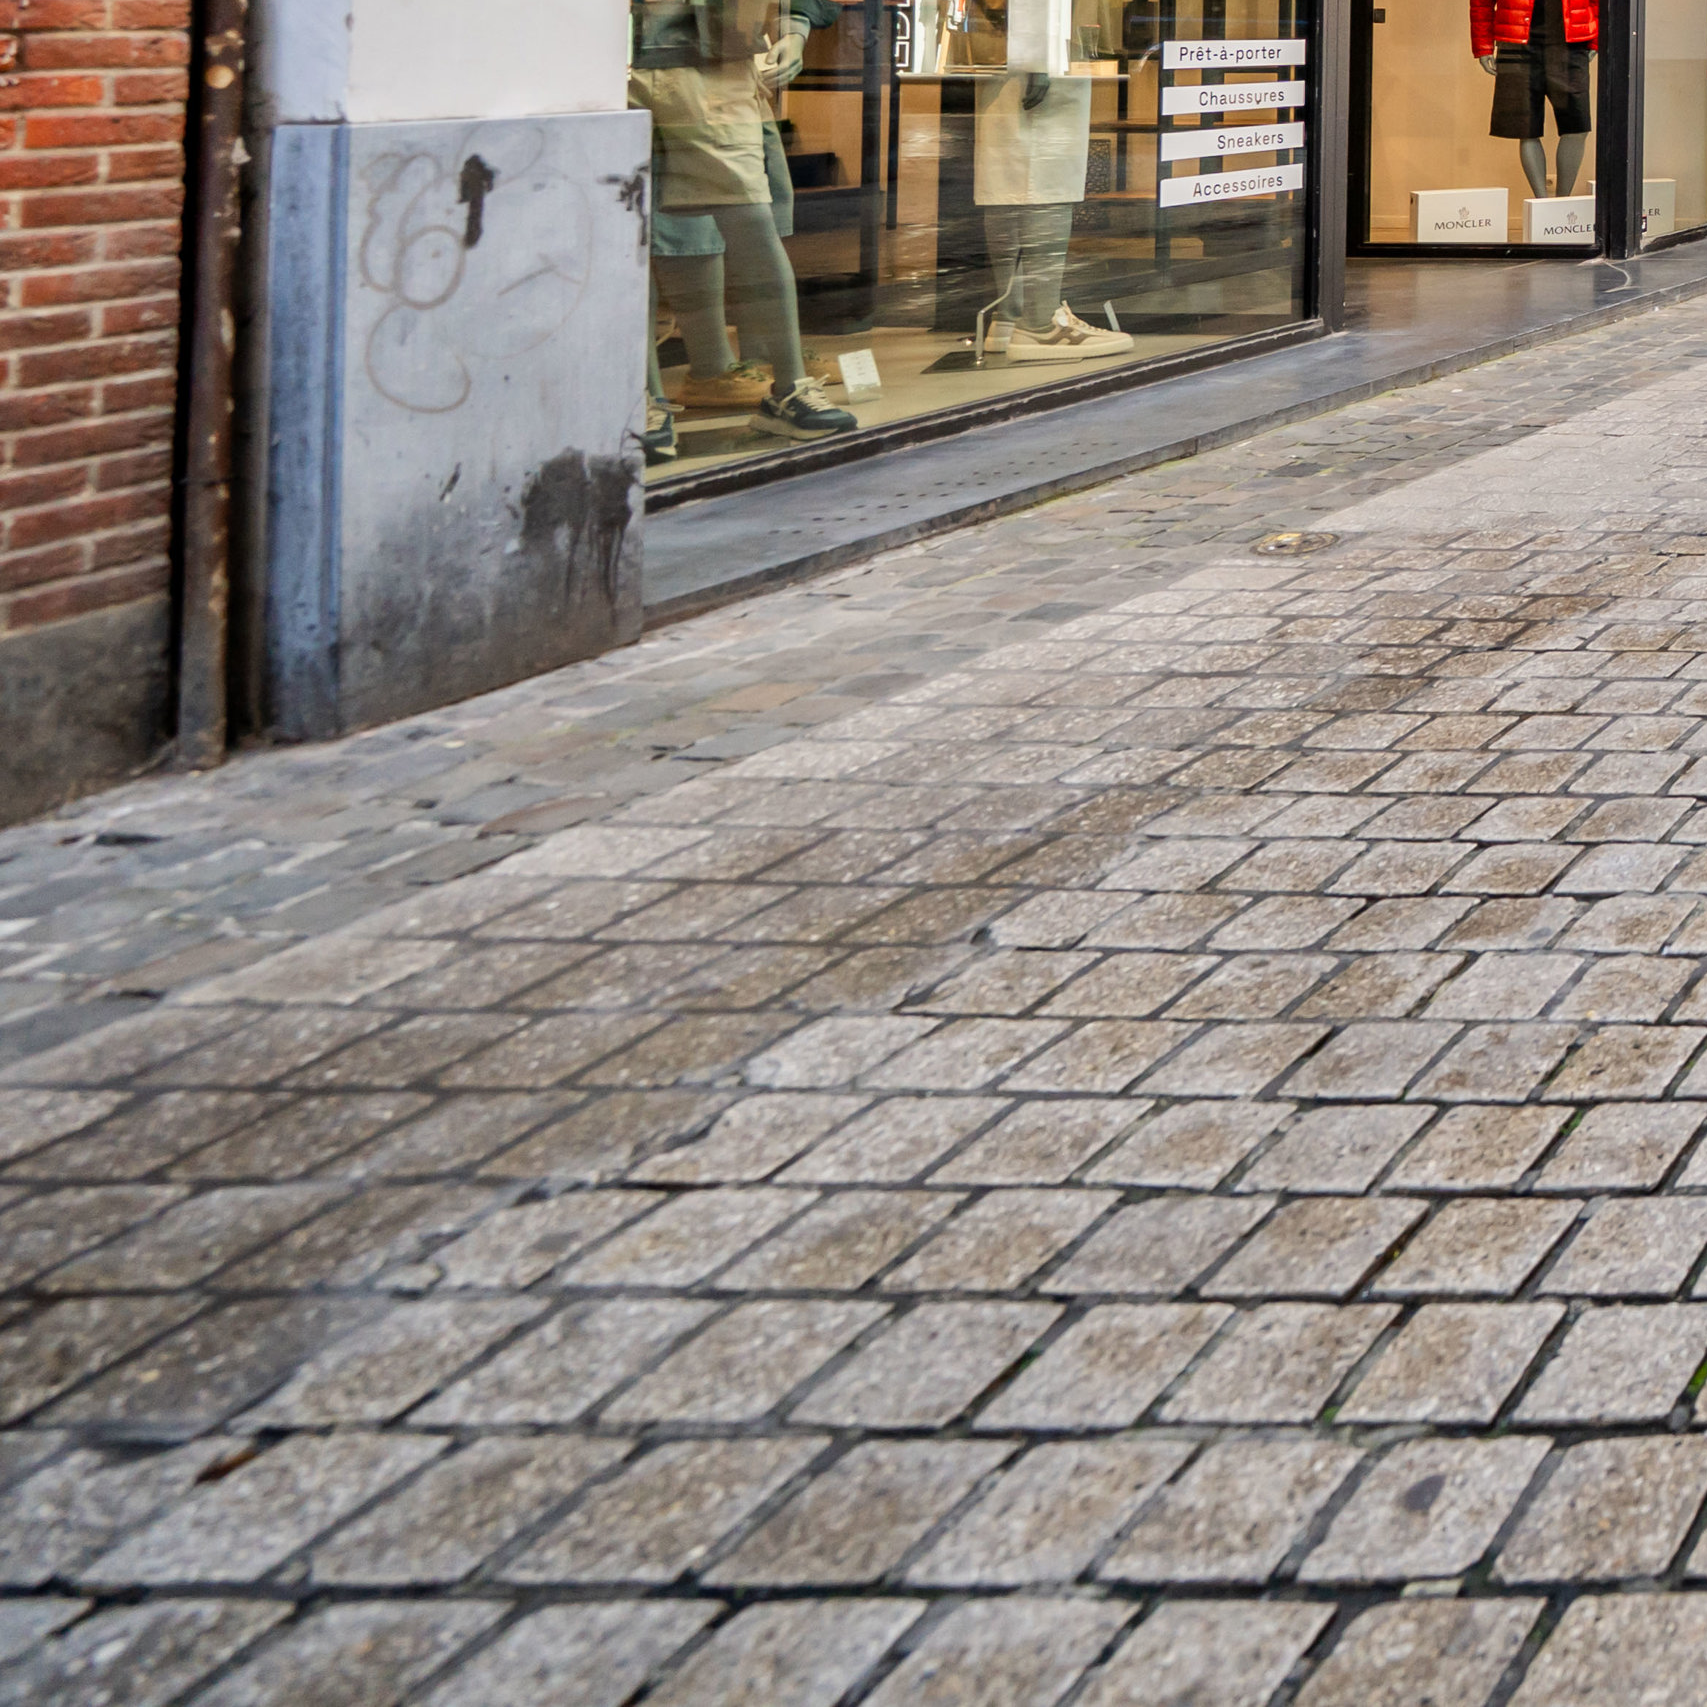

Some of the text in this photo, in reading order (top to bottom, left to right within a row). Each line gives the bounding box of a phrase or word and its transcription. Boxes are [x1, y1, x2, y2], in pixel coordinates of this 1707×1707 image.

[1179, 45, 1282, 63] Prêt-à-porter
[1199, 90, 1285, 107] Chaussures
[1217, 131, 1284, 150] Sneakers
[1192, 175, 1283, 198] Accessoires
[1434, 218, 1492, 231] MONCLER
[1543, 222, 1597, 236] MONCLE
